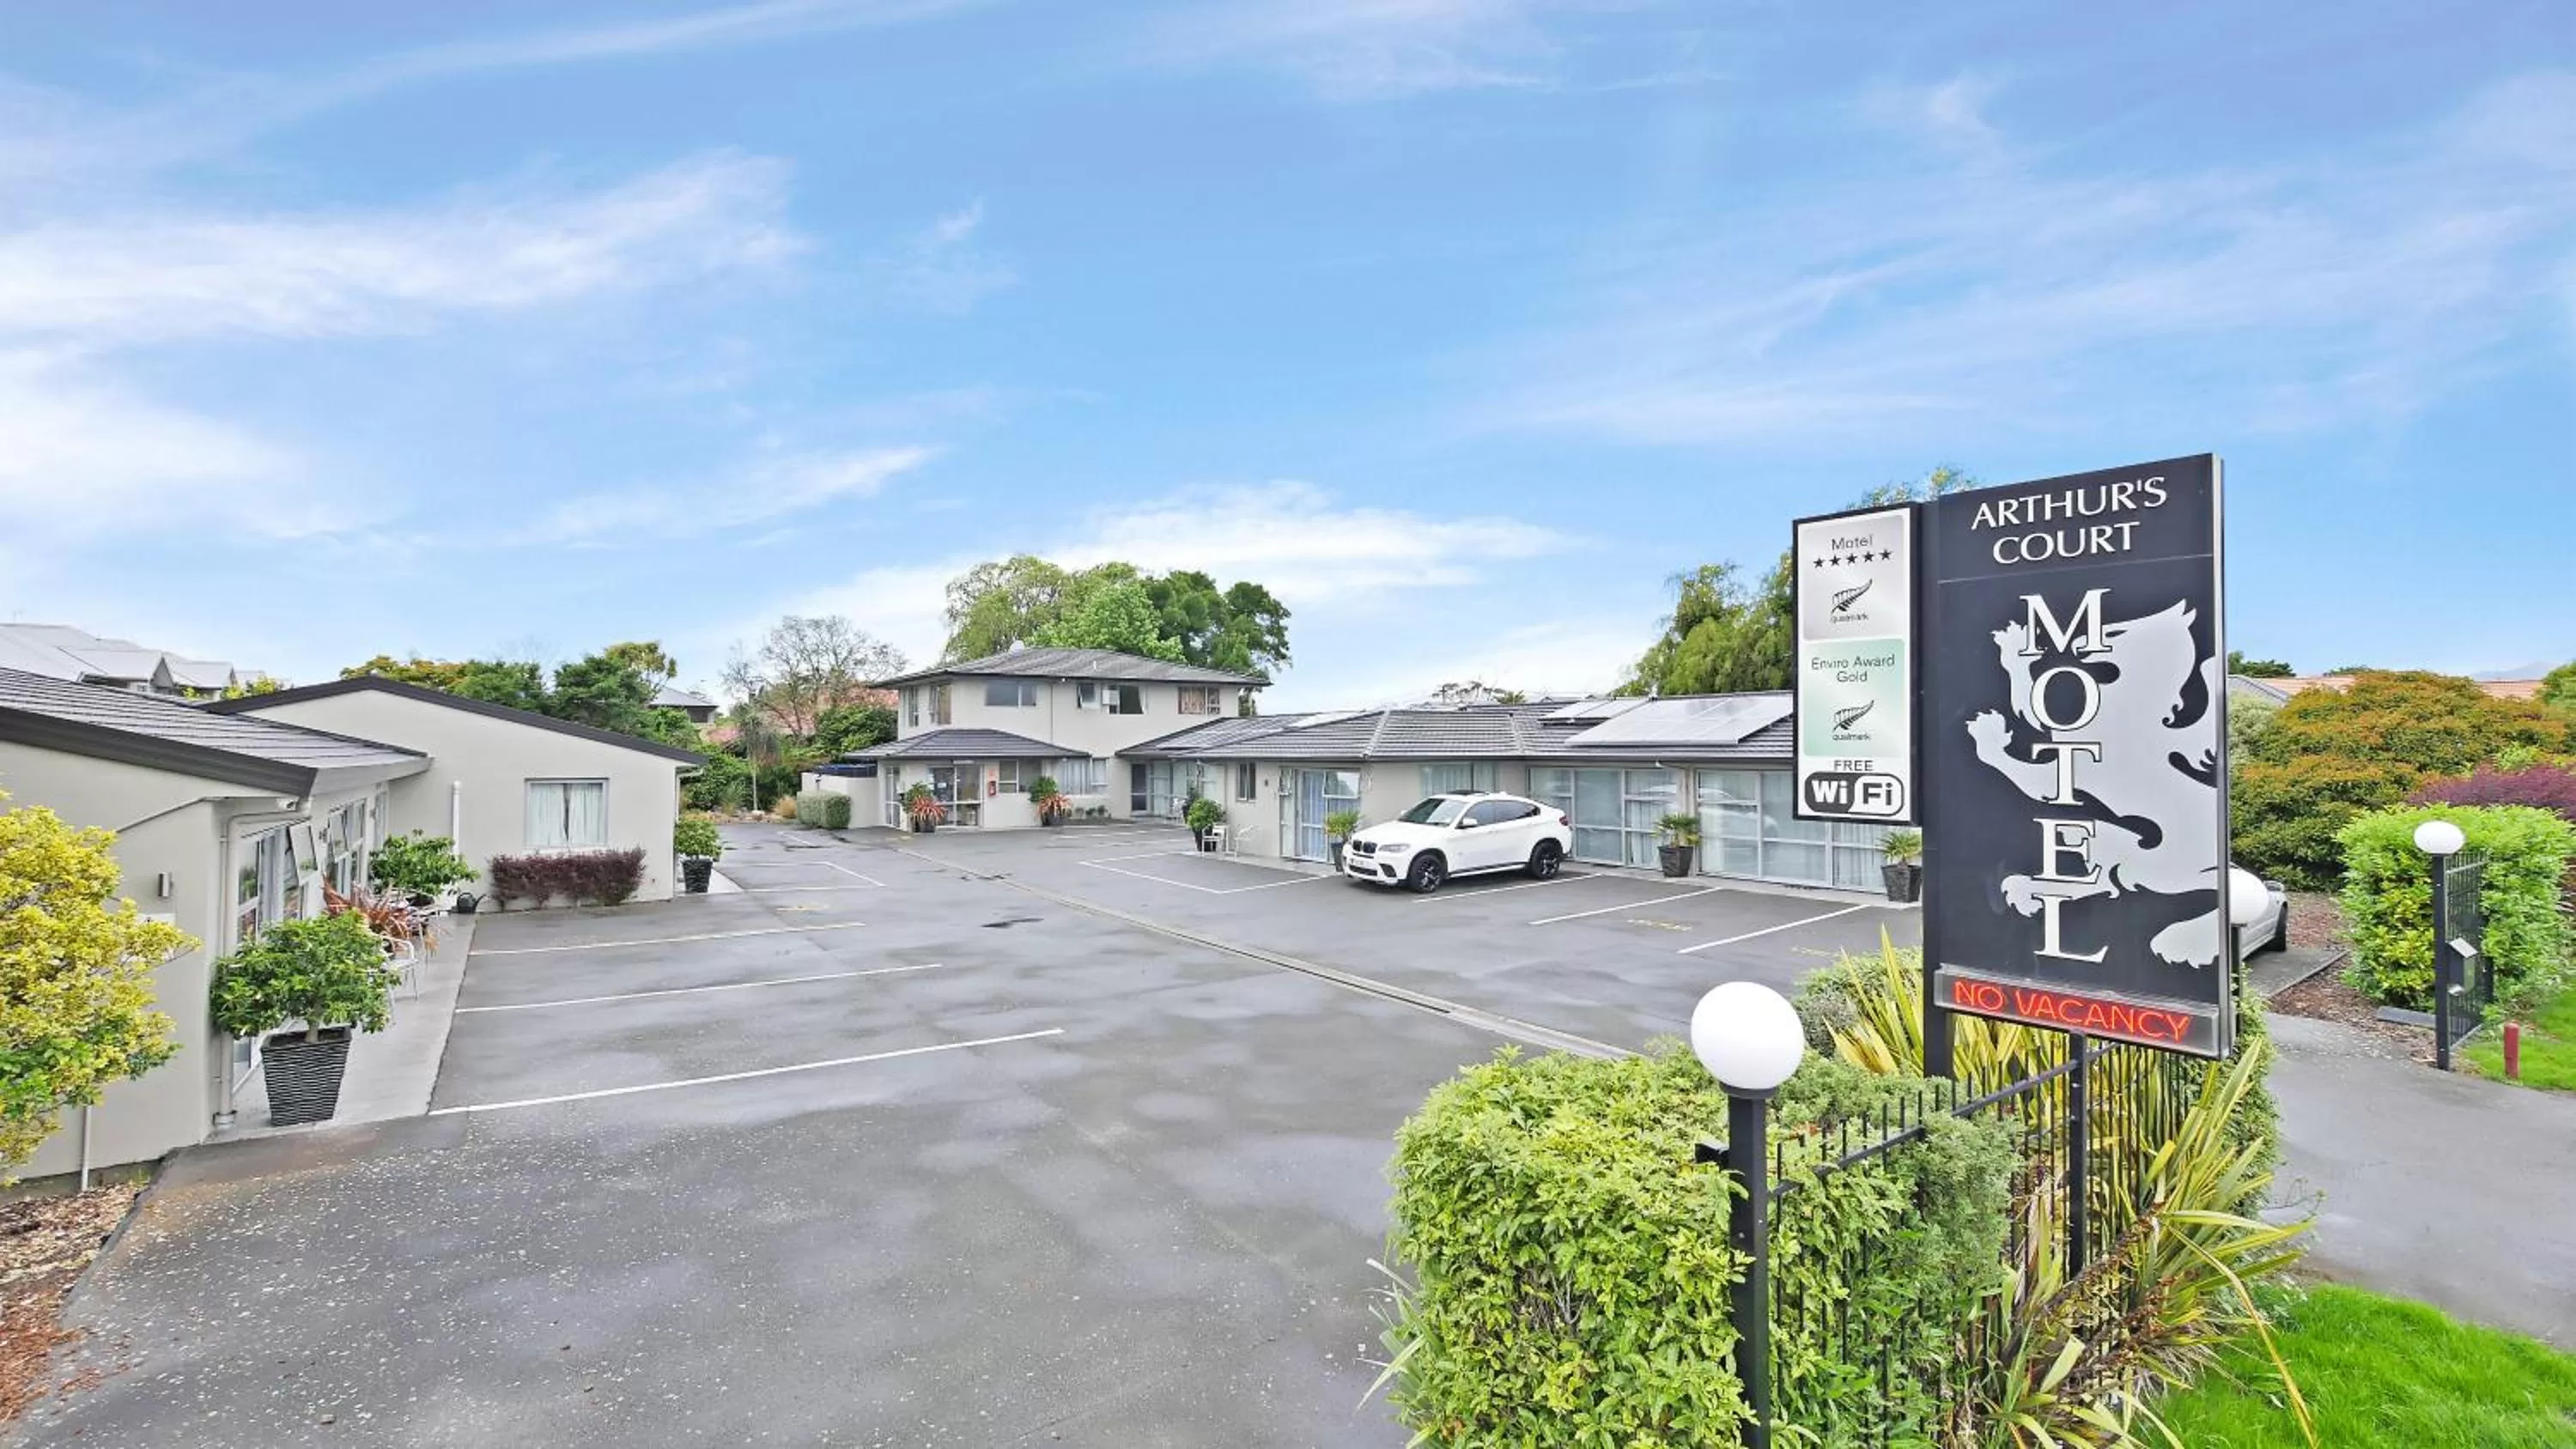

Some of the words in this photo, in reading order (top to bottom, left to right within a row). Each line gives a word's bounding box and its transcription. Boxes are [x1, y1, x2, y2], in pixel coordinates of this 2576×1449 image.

[1971, 476, 2167, 530] ARTHUR'S
[1832, 534, 1873, 550] Motel
[1993, 521, 2140, 564] COURT
[1811, 658, 1849, 670] Enviro
[1853, 653, 1895, 667] Award
[1836, 670, 1868, 682] Gold
[1833, 761, 1874, 771] FREE
[2019, 588, 2113, 963] MOTEL
[1954, 981, 2006, 1010] NO
[2015, 991, 2190, 1041] VACANCY
